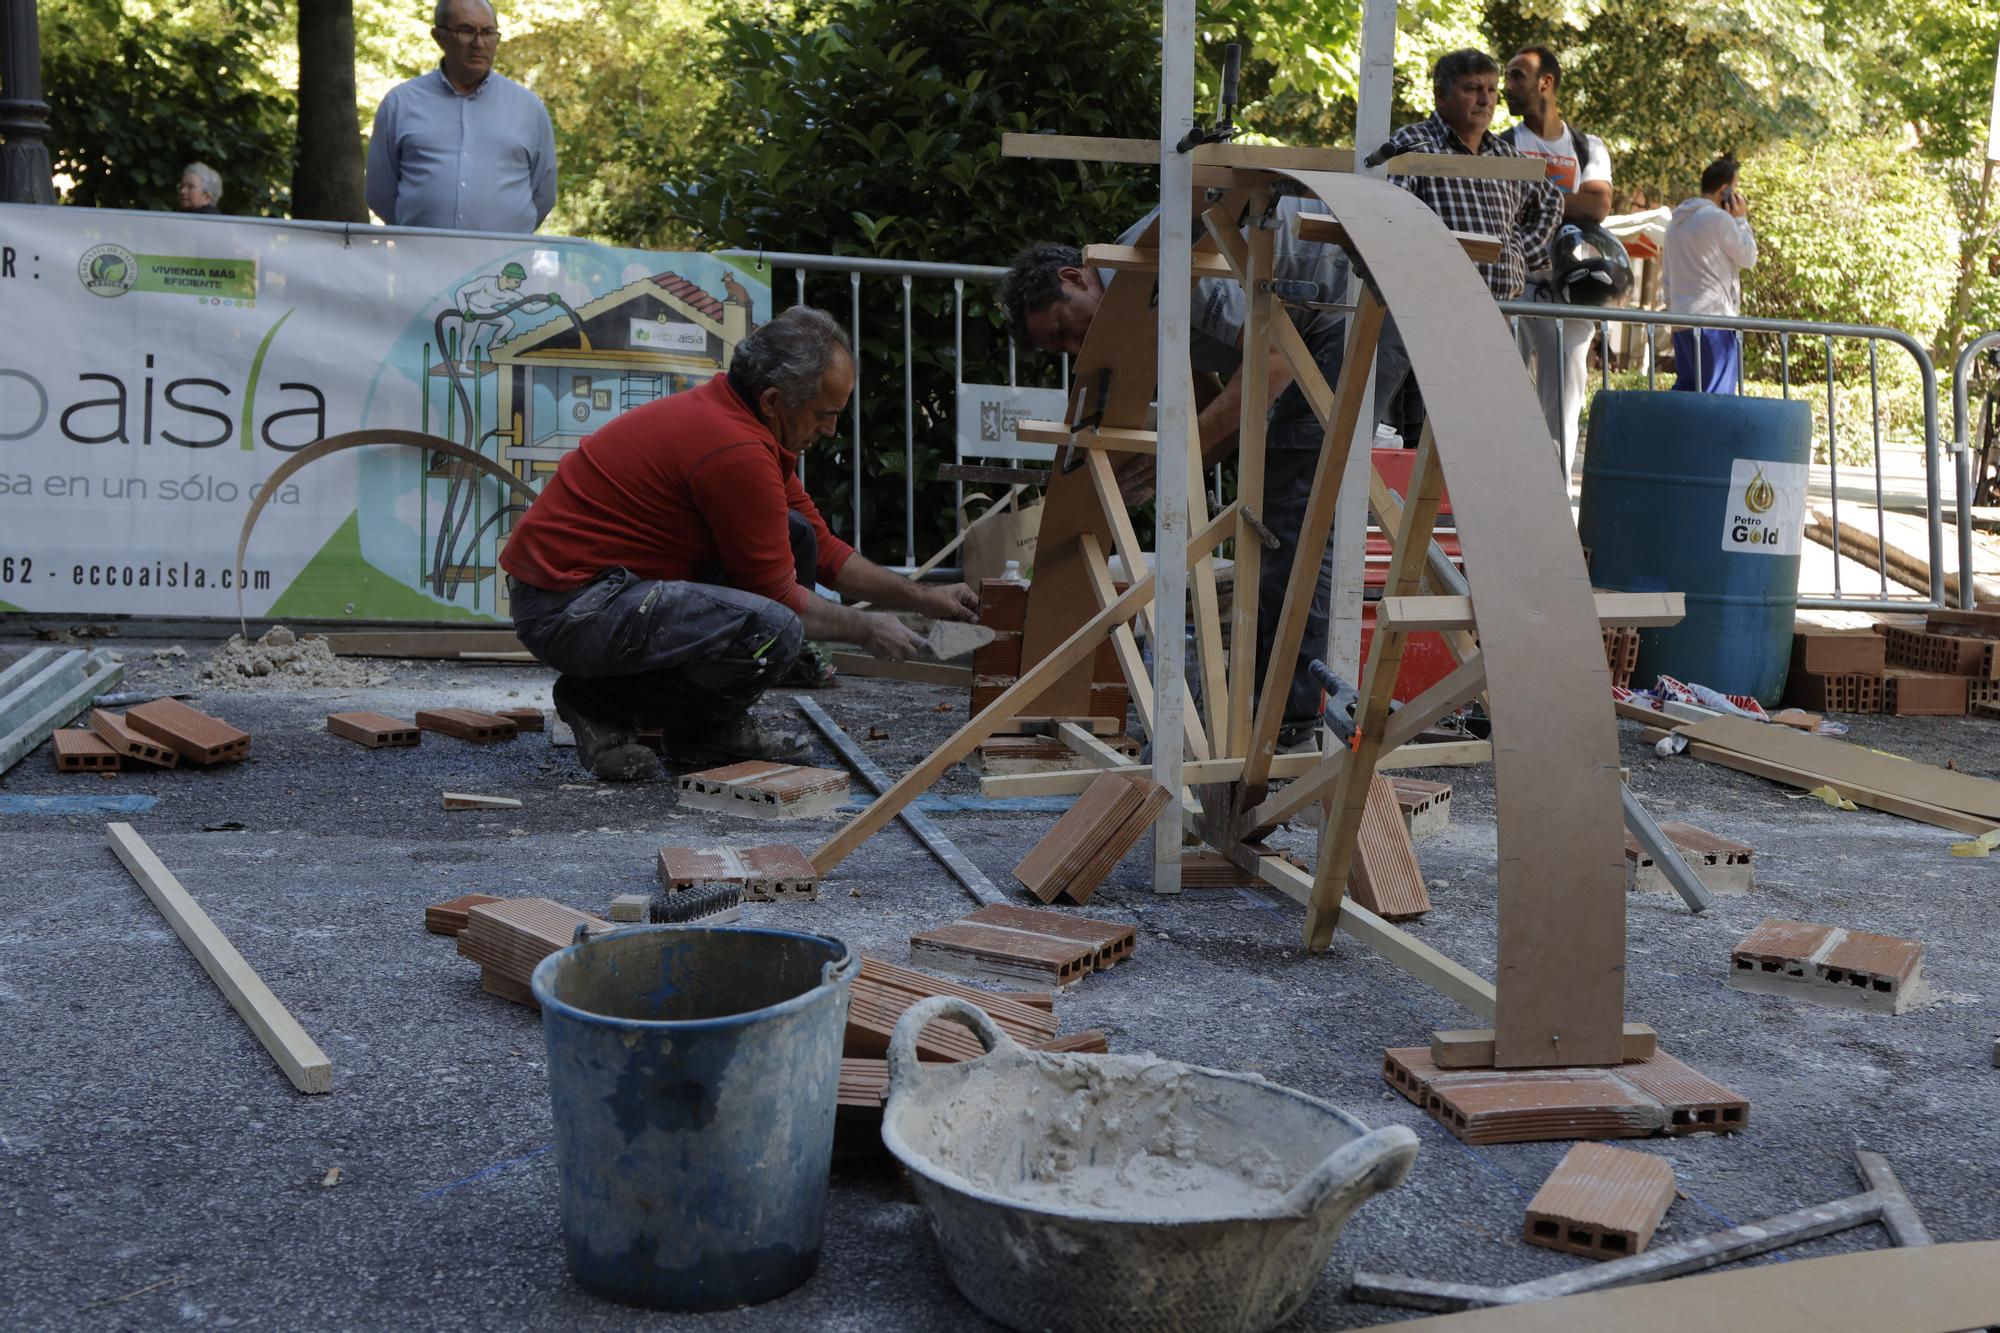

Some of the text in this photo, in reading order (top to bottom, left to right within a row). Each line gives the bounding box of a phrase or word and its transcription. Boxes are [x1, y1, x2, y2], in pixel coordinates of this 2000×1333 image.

[152, 265, 206, 278] VIVIENDA
[163, 277, 222, 289] EFICIENTE
[44, 474, 90, 497] en
[103, 477, 147, 500] un
[158, 474, 239, 503] sólo
[1734, 515, 1762, 526] Petro
[1731, 525, 1779, 545] Gold
[2, 556, 33, 585] 62
[72, 561, 271, 590] eccoaisla.com
